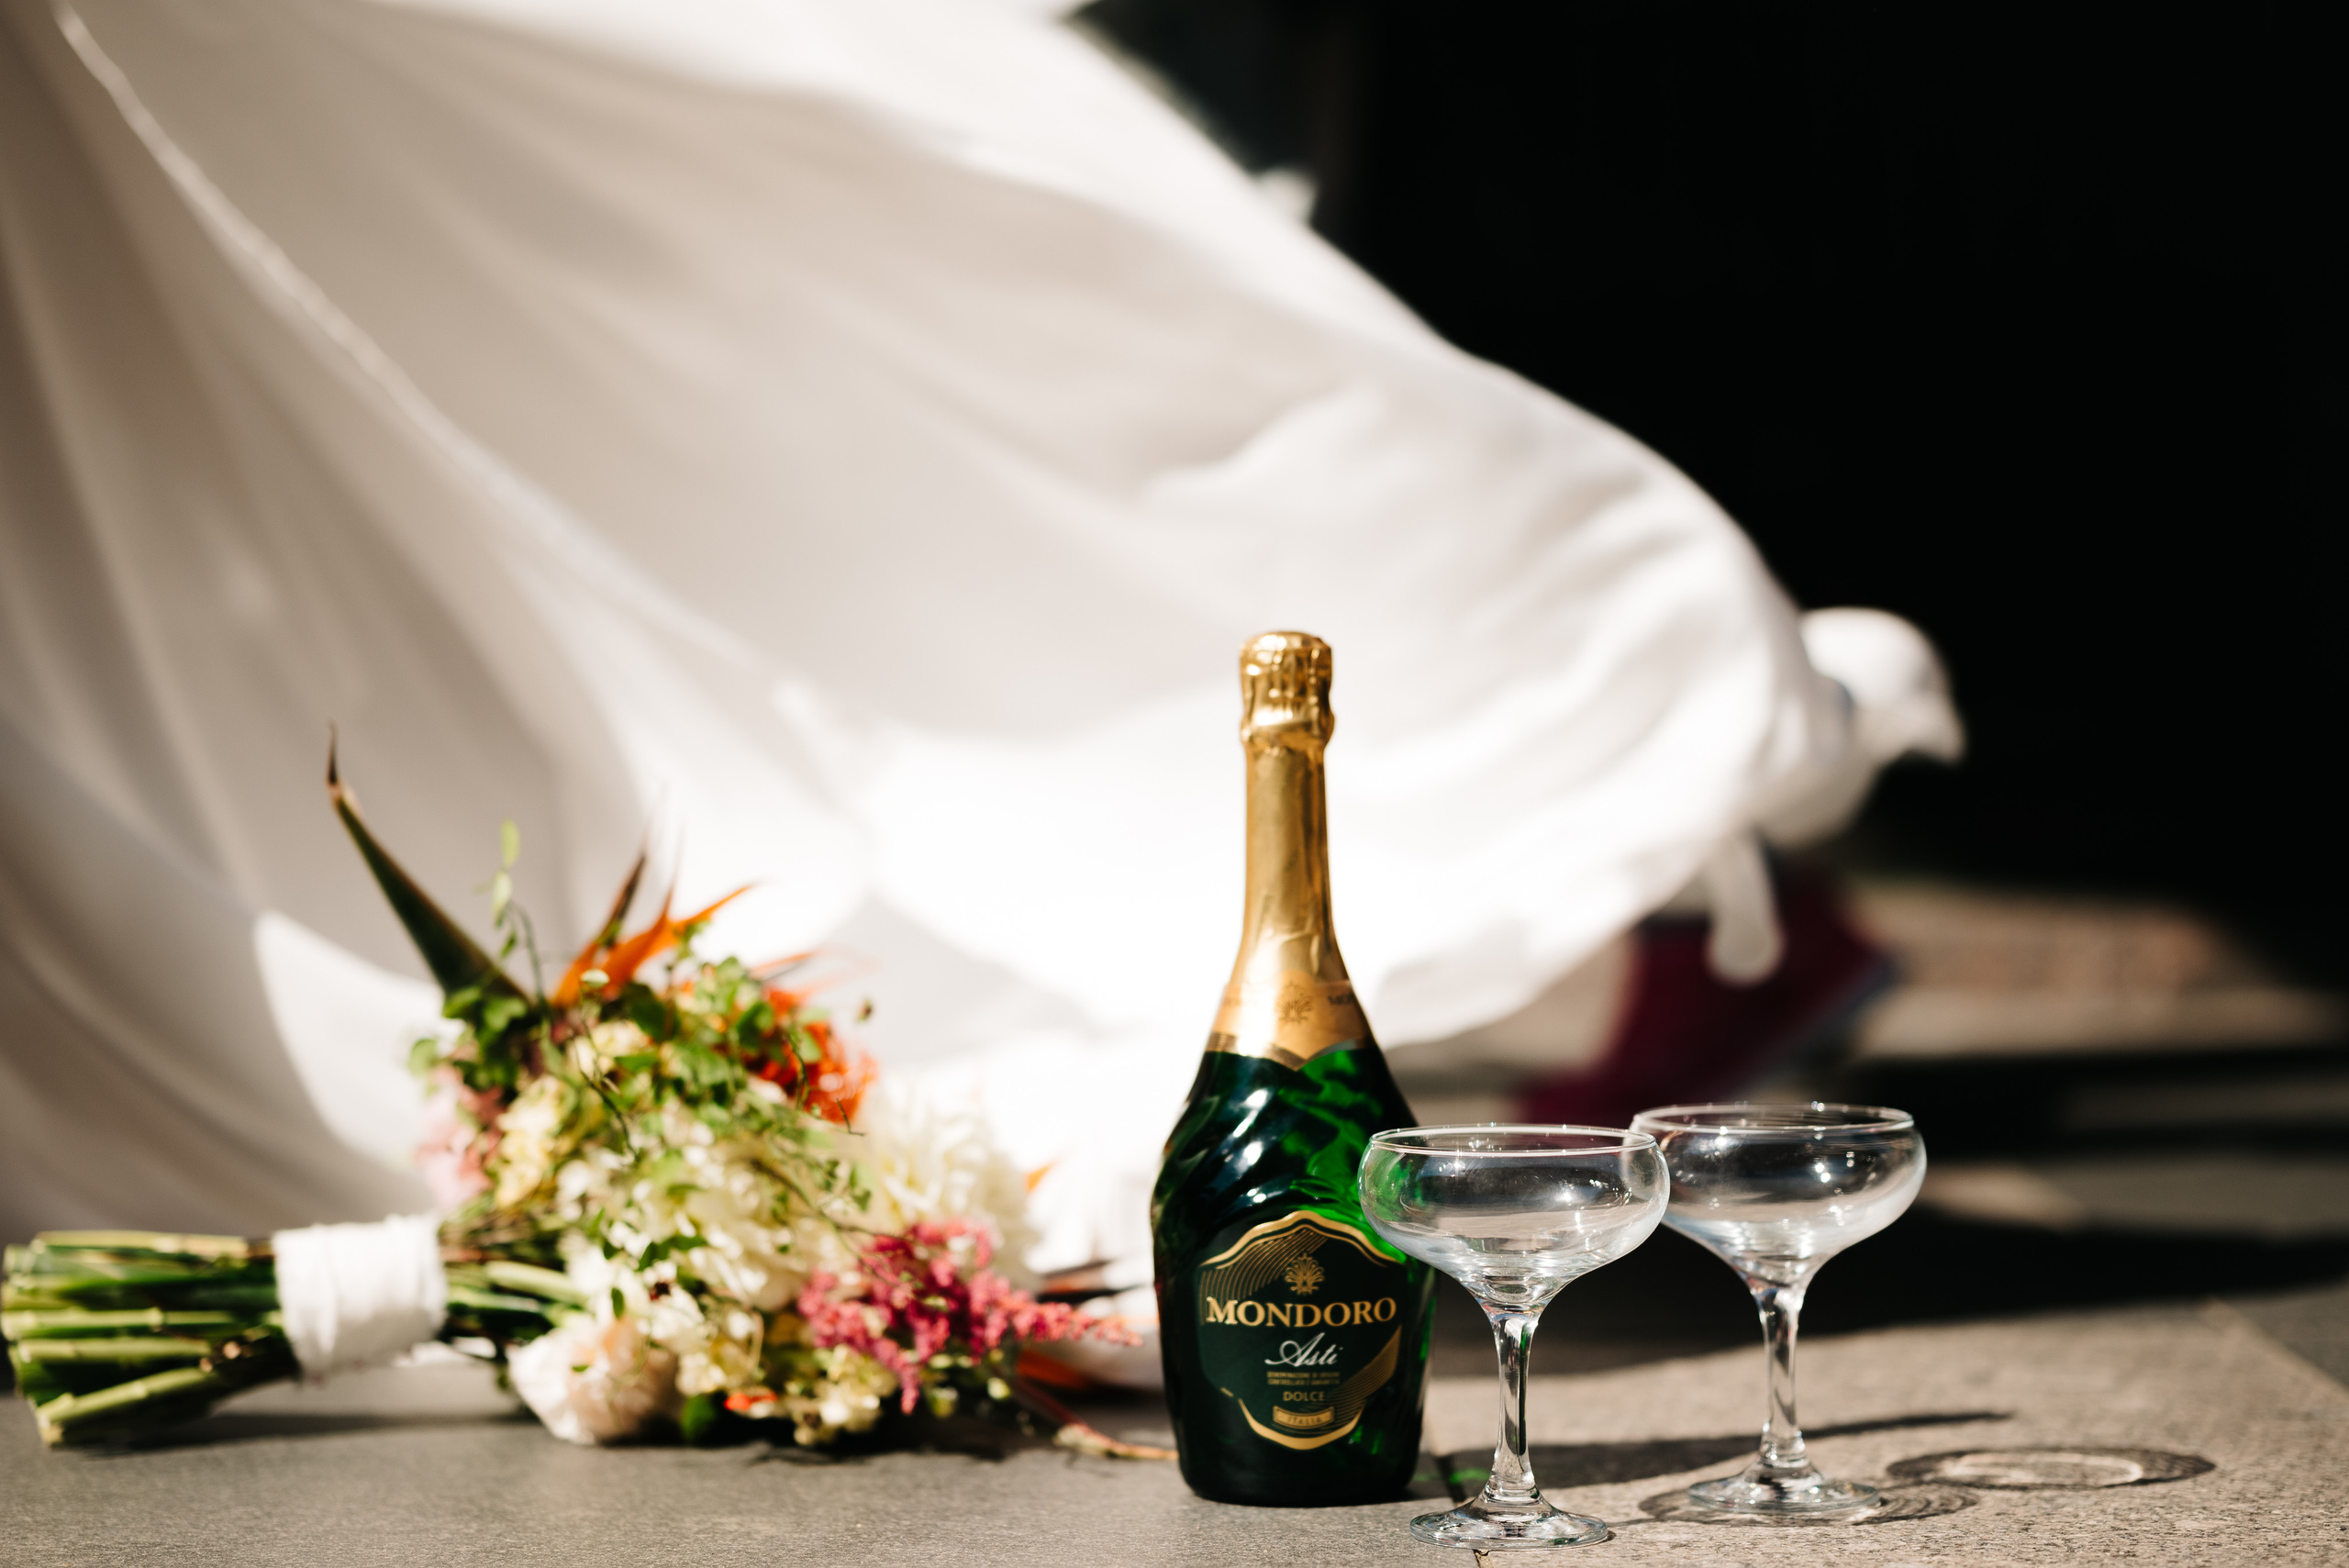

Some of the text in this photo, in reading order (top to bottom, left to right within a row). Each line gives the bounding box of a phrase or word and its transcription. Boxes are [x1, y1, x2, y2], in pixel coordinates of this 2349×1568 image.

[1206, 1296, 1397, 1328] MONDORO
[1264, 1332, 1343, 1367] Asti
[1283, 1391, 1325, 1402] DOLCE
[1287, 1415, 1322, 1426] ITALIA
